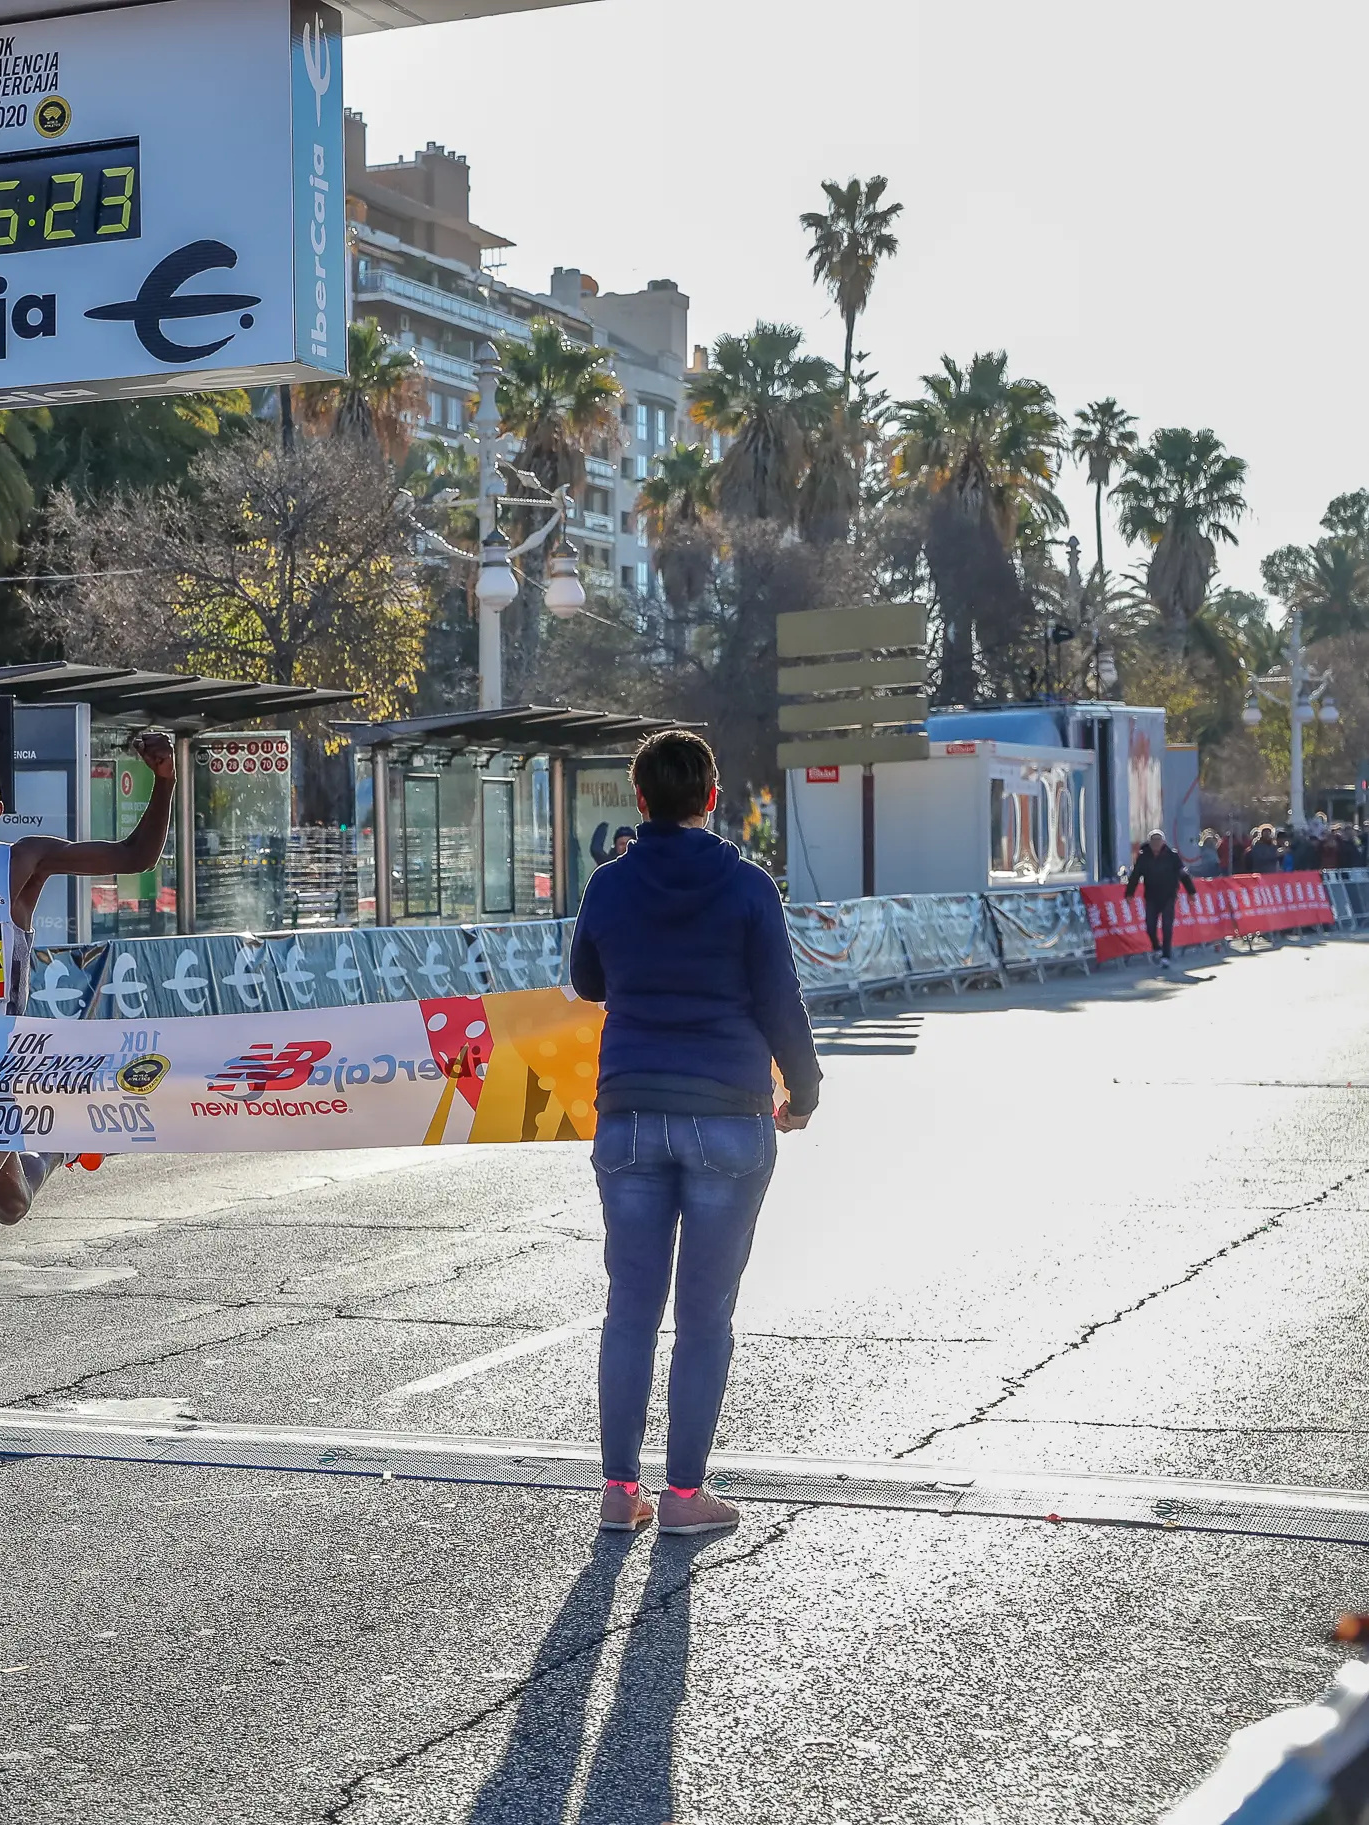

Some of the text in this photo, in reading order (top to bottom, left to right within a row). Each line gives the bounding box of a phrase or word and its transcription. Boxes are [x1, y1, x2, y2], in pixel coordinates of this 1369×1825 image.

[309, 143, 329, 358] iberCaja
[2, 814, 44, 827] Galaxy
[5, 1033, 54, 1055] 10K
[190, 1098, 349, 1117] new balance
